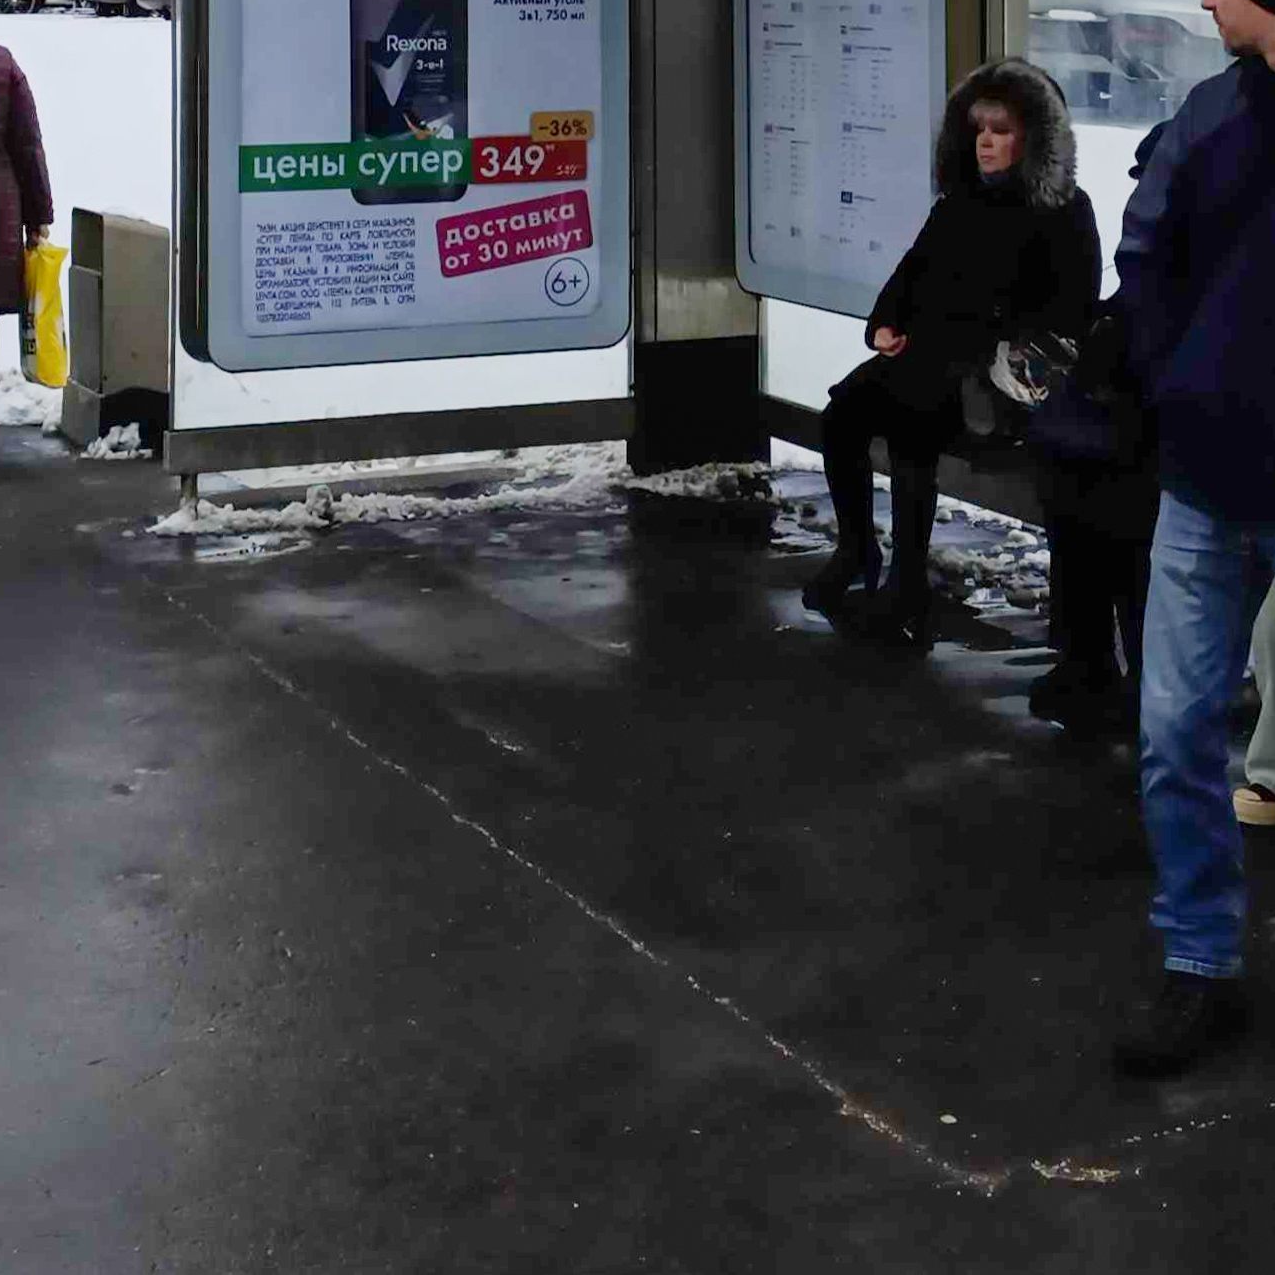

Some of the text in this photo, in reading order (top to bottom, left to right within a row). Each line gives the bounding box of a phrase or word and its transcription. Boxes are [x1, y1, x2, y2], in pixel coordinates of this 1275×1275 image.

[546, 9, 567, 21] 750
[386, 35, 448, 52] Rexona
[538, 119, 588, 136] -36%
[253, 149, 464, 186] цены супер
[444, 203, 576, 249] доставка
[445, 228, 584, 270] от 30 минут
[552, 270, 581, 294] 6+
